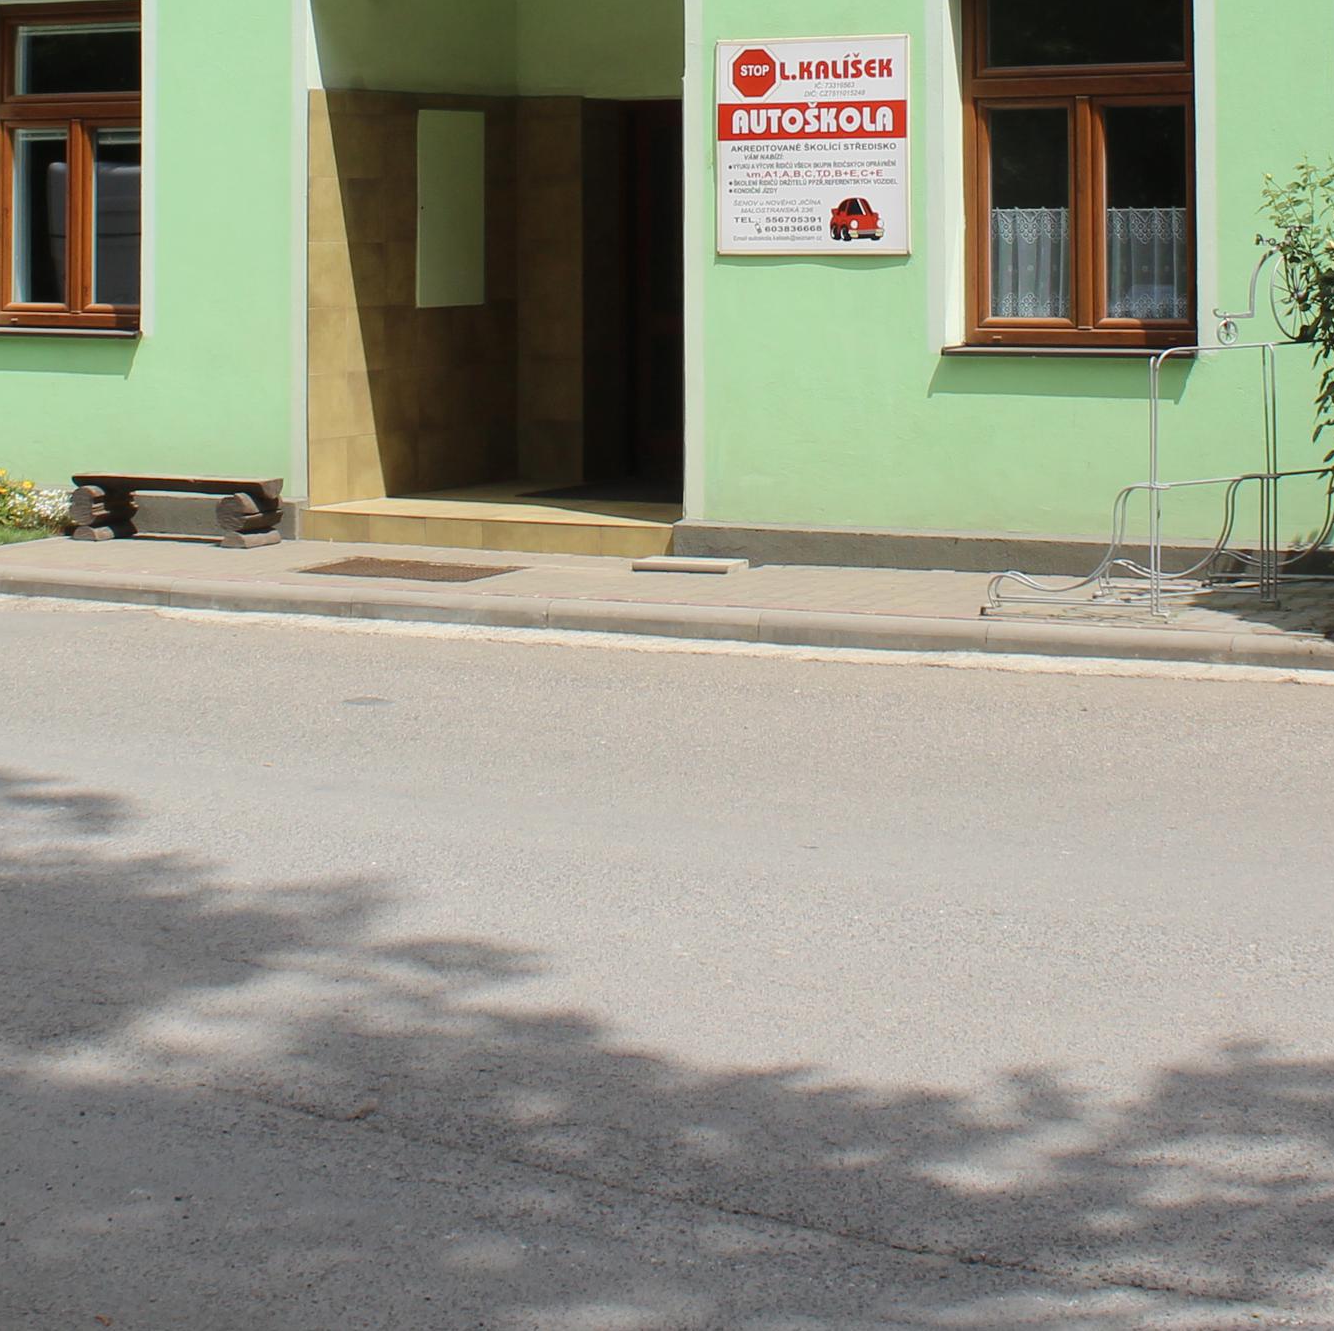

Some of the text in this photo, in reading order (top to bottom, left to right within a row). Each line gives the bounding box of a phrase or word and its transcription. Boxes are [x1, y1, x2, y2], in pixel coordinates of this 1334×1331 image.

[740, 64, 770, 77] STOP
[731, 102, 894, 135] AUTOŠKOLA
[731, 142, 897, 152] AKREDITOVANÉ ŠKOLÍCÍ STŘEDISKO
